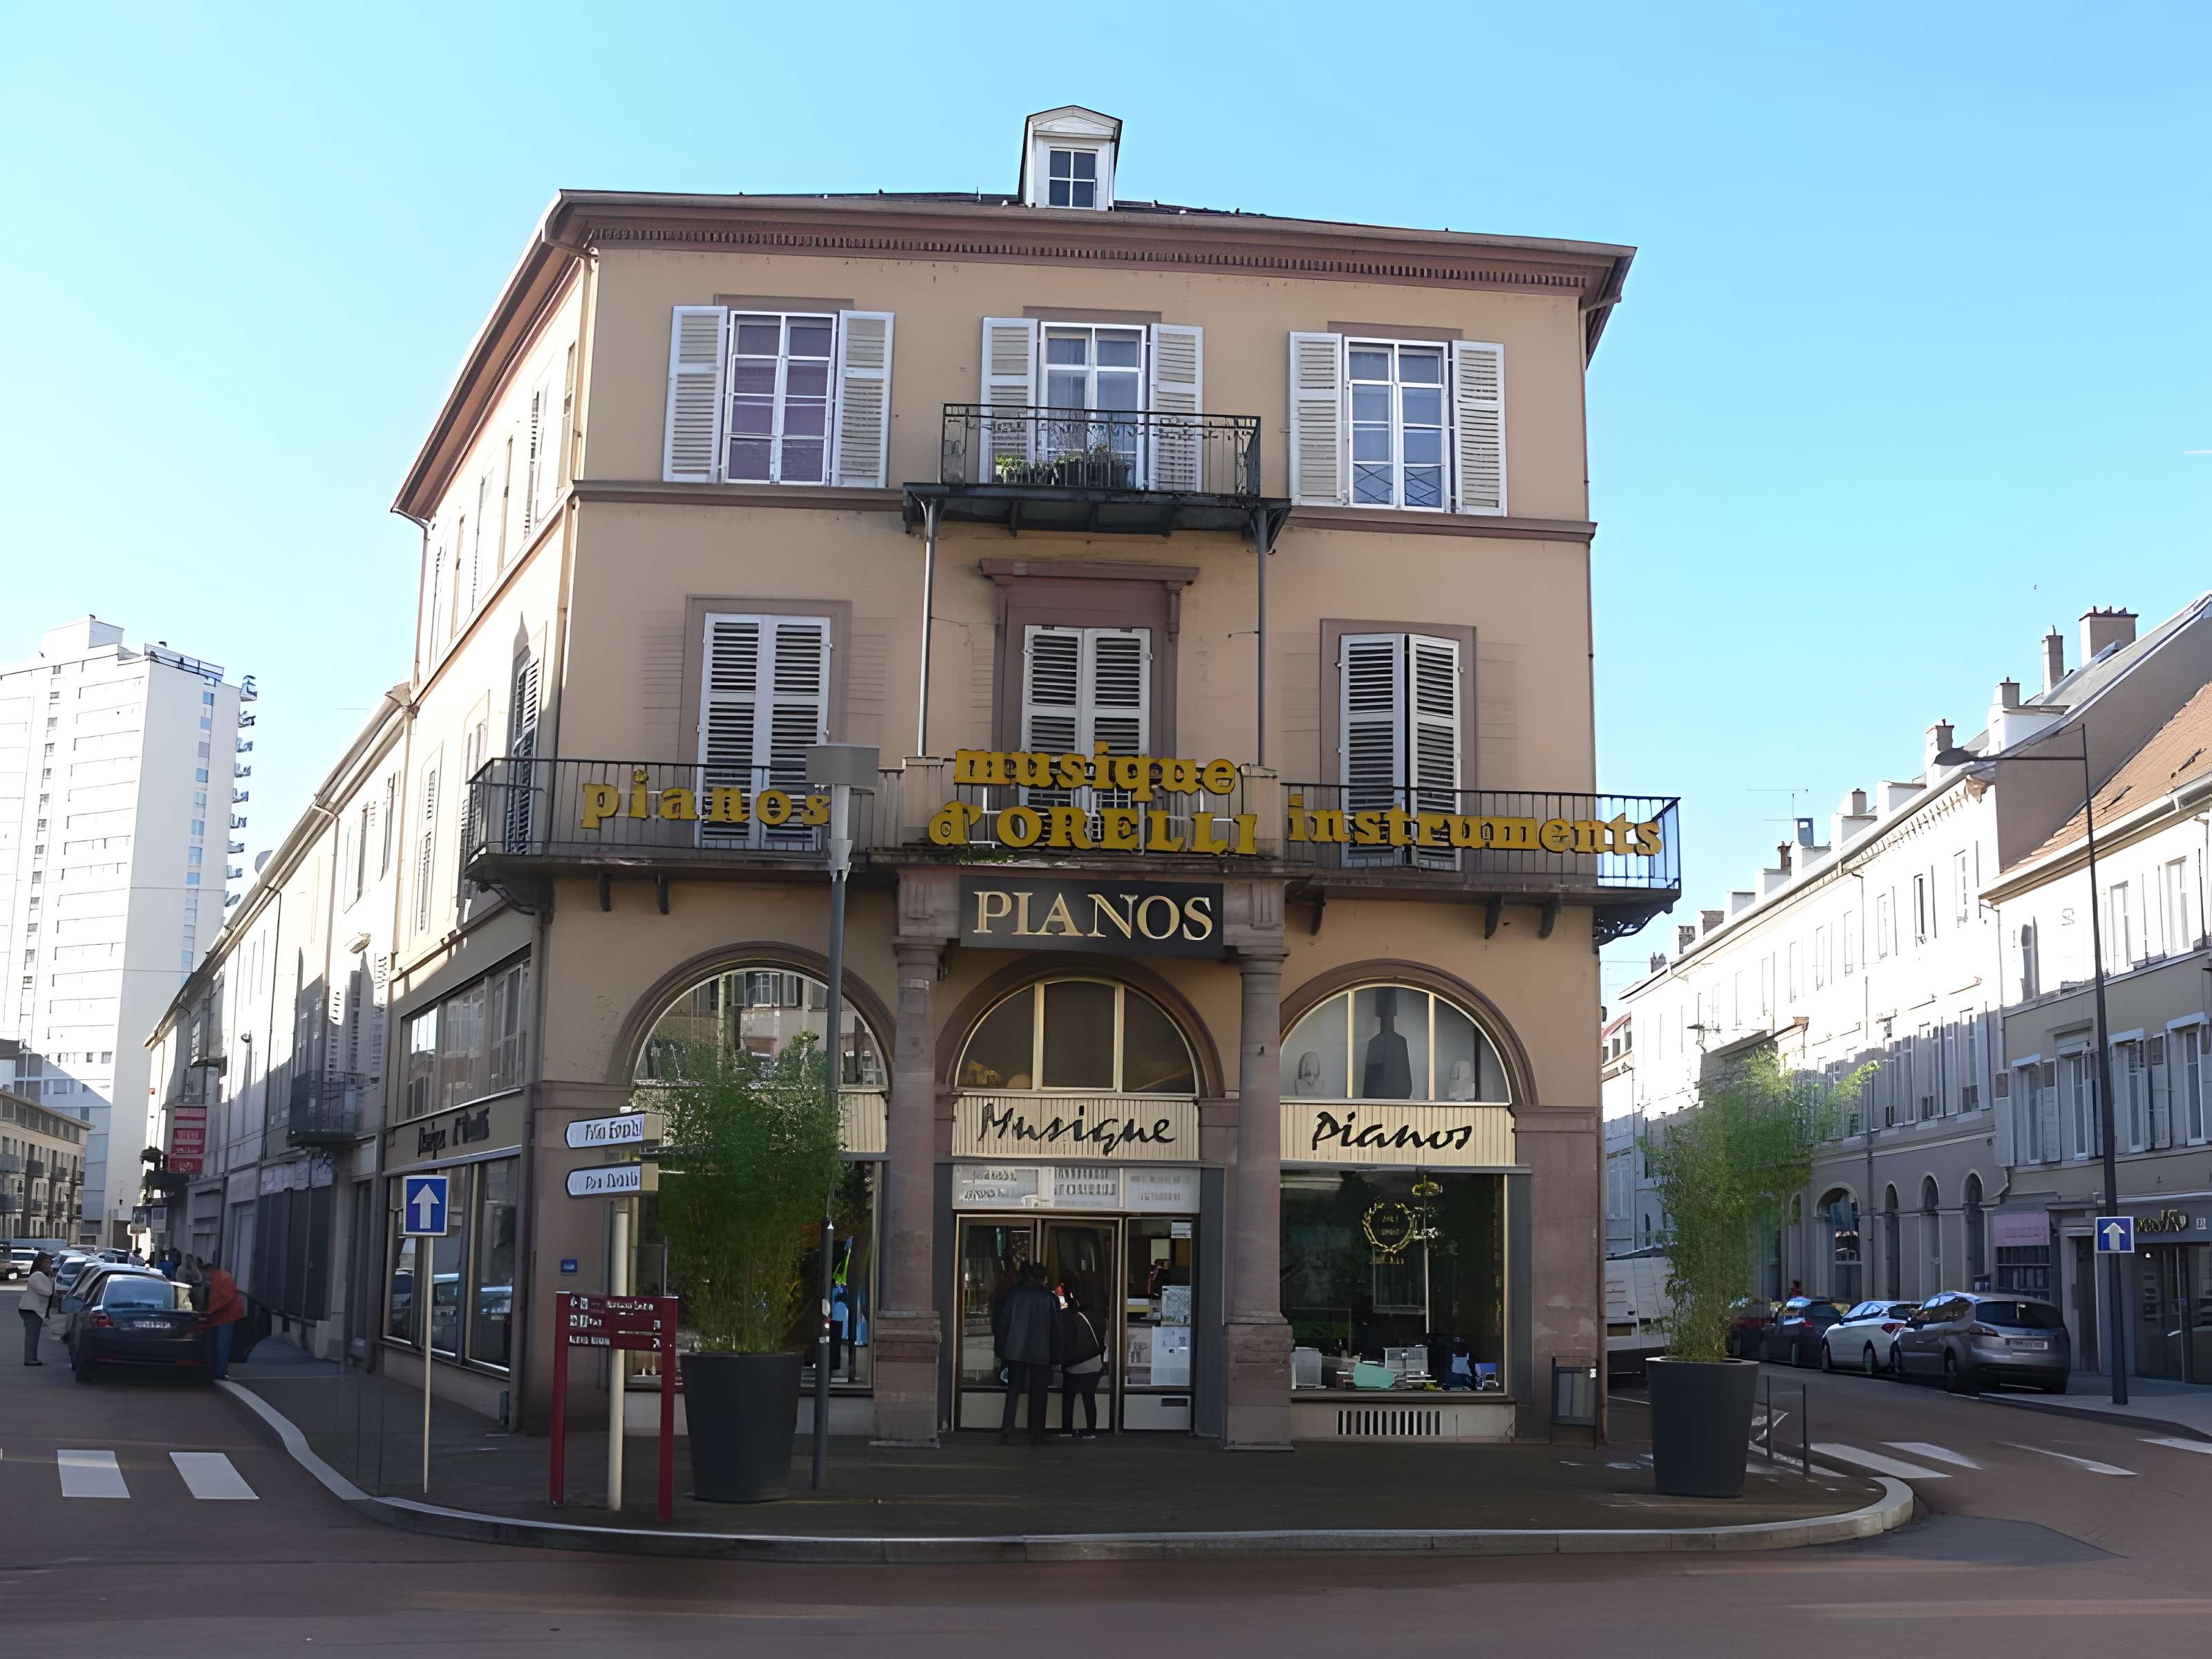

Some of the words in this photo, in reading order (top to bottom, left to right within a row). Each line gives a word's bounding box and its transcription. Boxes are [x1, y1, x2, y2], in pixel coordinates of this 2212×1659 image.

[580, 768, 831, 829] pianos
[954, 740, 1237, 803] musique
[1287, 794, 1663, 856] instruments
[973, 890, 1213, 941] PIANOS
[978, 1102, 1177, 1156] Musique
